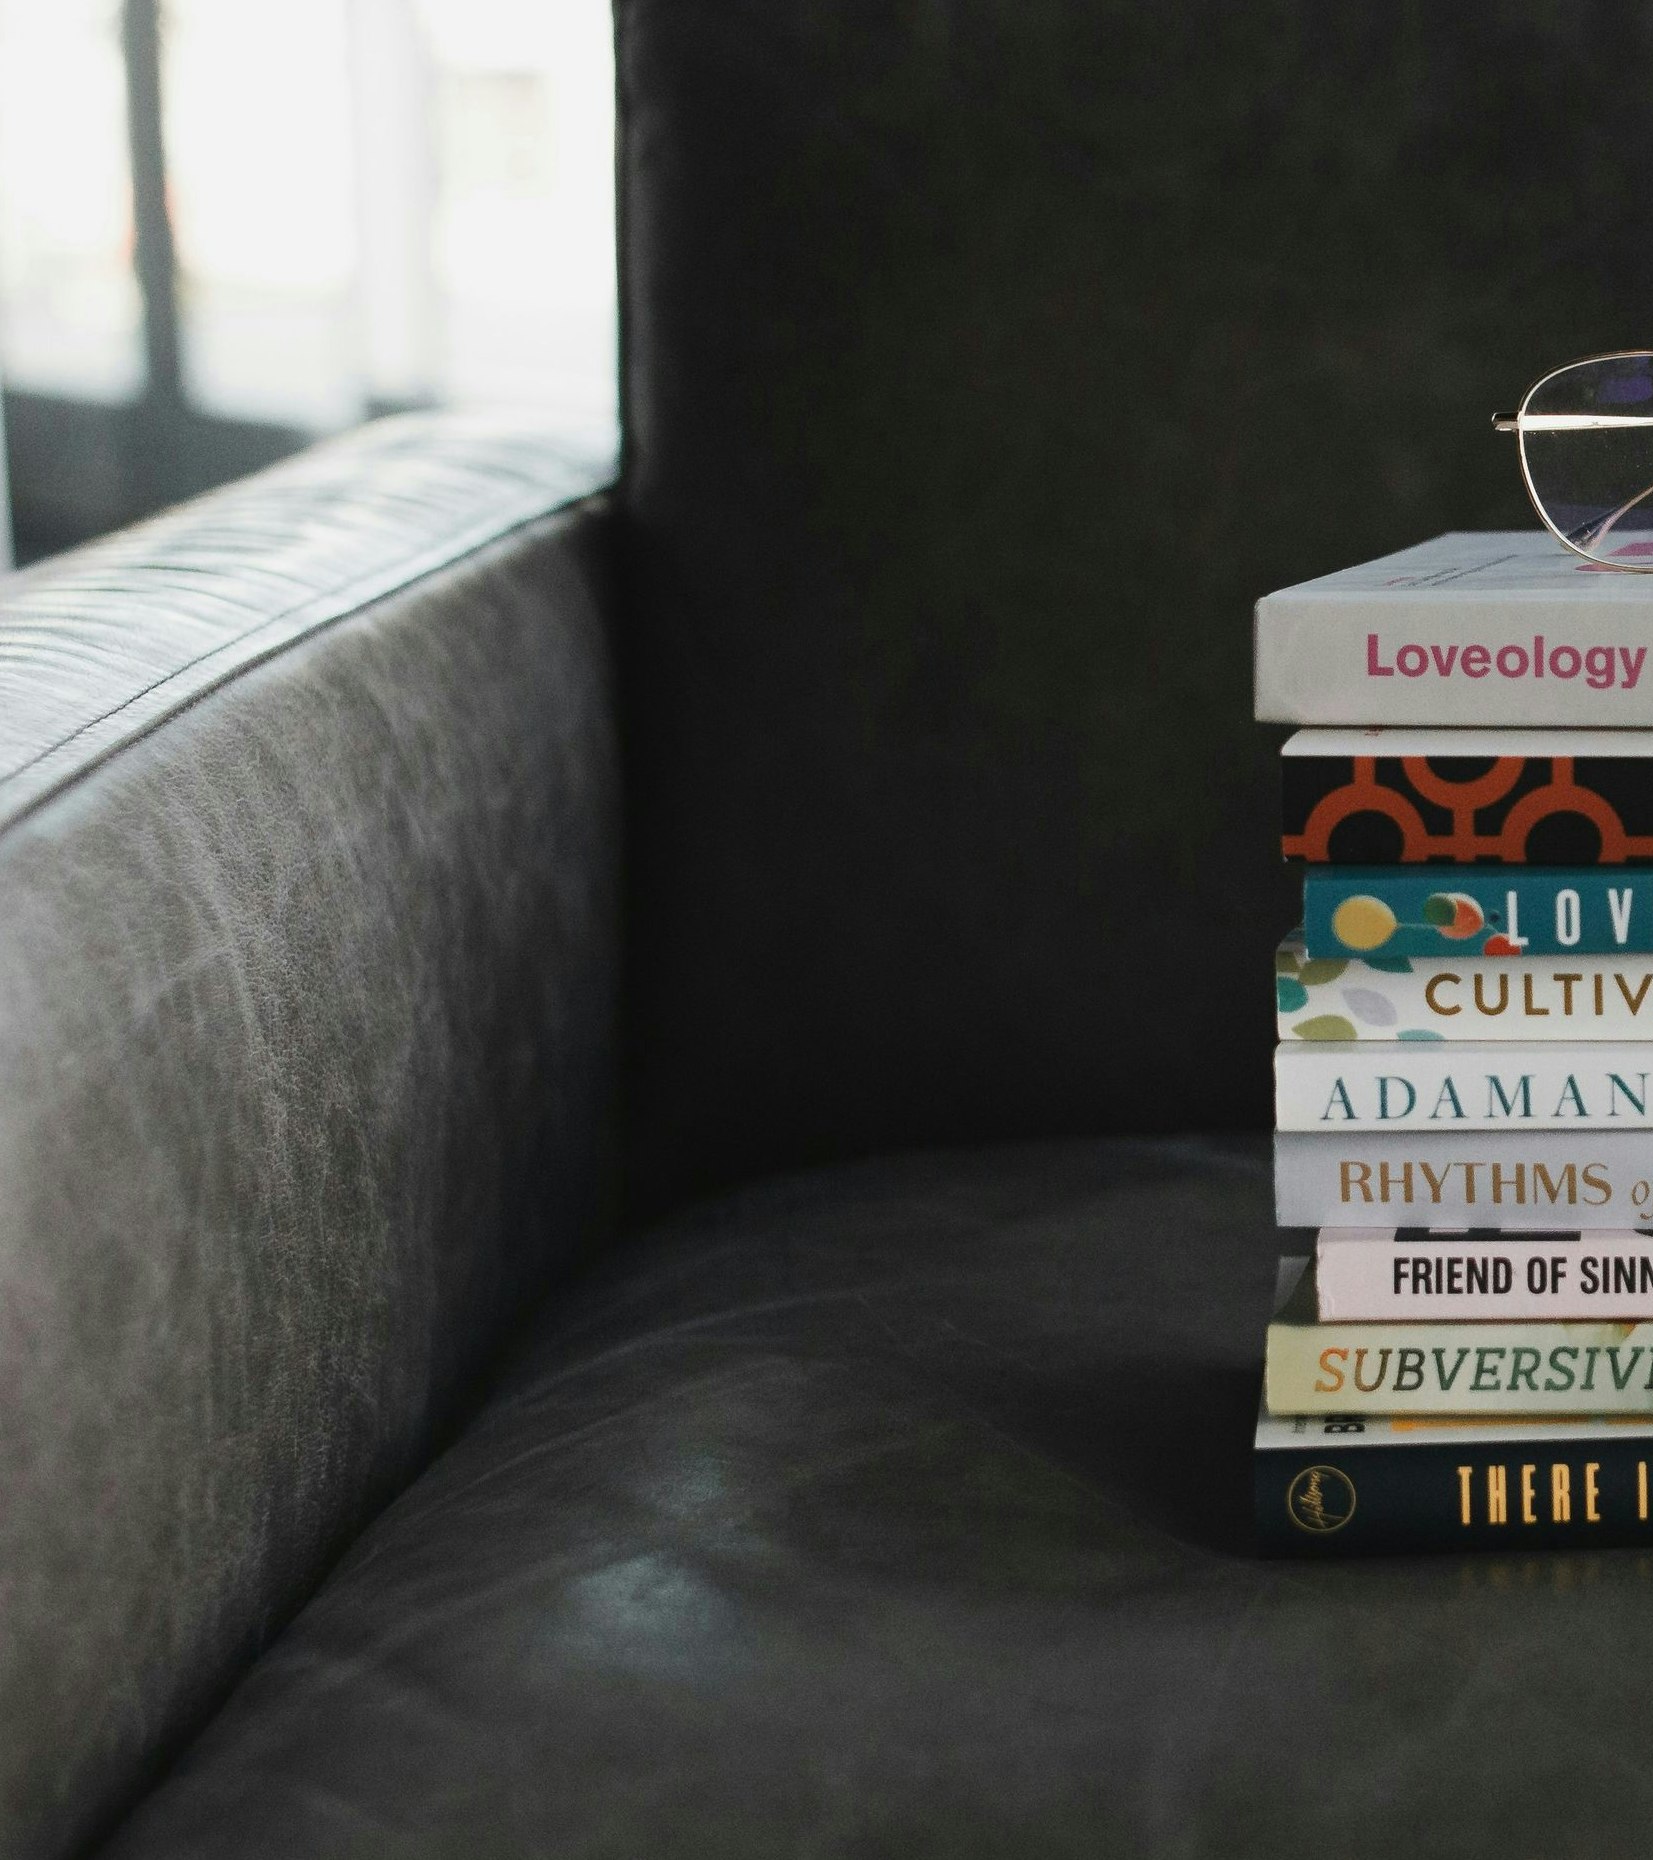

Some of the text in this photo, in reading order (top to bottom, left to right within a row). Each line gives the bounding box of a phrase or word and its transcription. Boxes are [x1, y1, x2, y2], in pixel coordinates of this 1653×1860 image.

[1367, 634, 1647, 689] Loveology
[1340, 1162, 1612, 1205] RHYTHMS
[1394, 1257, 1512, 1294] FRIEND
[1527, 1257, 1567, 1294] OF
[1458, 1463, 1600, 1524] THERE
